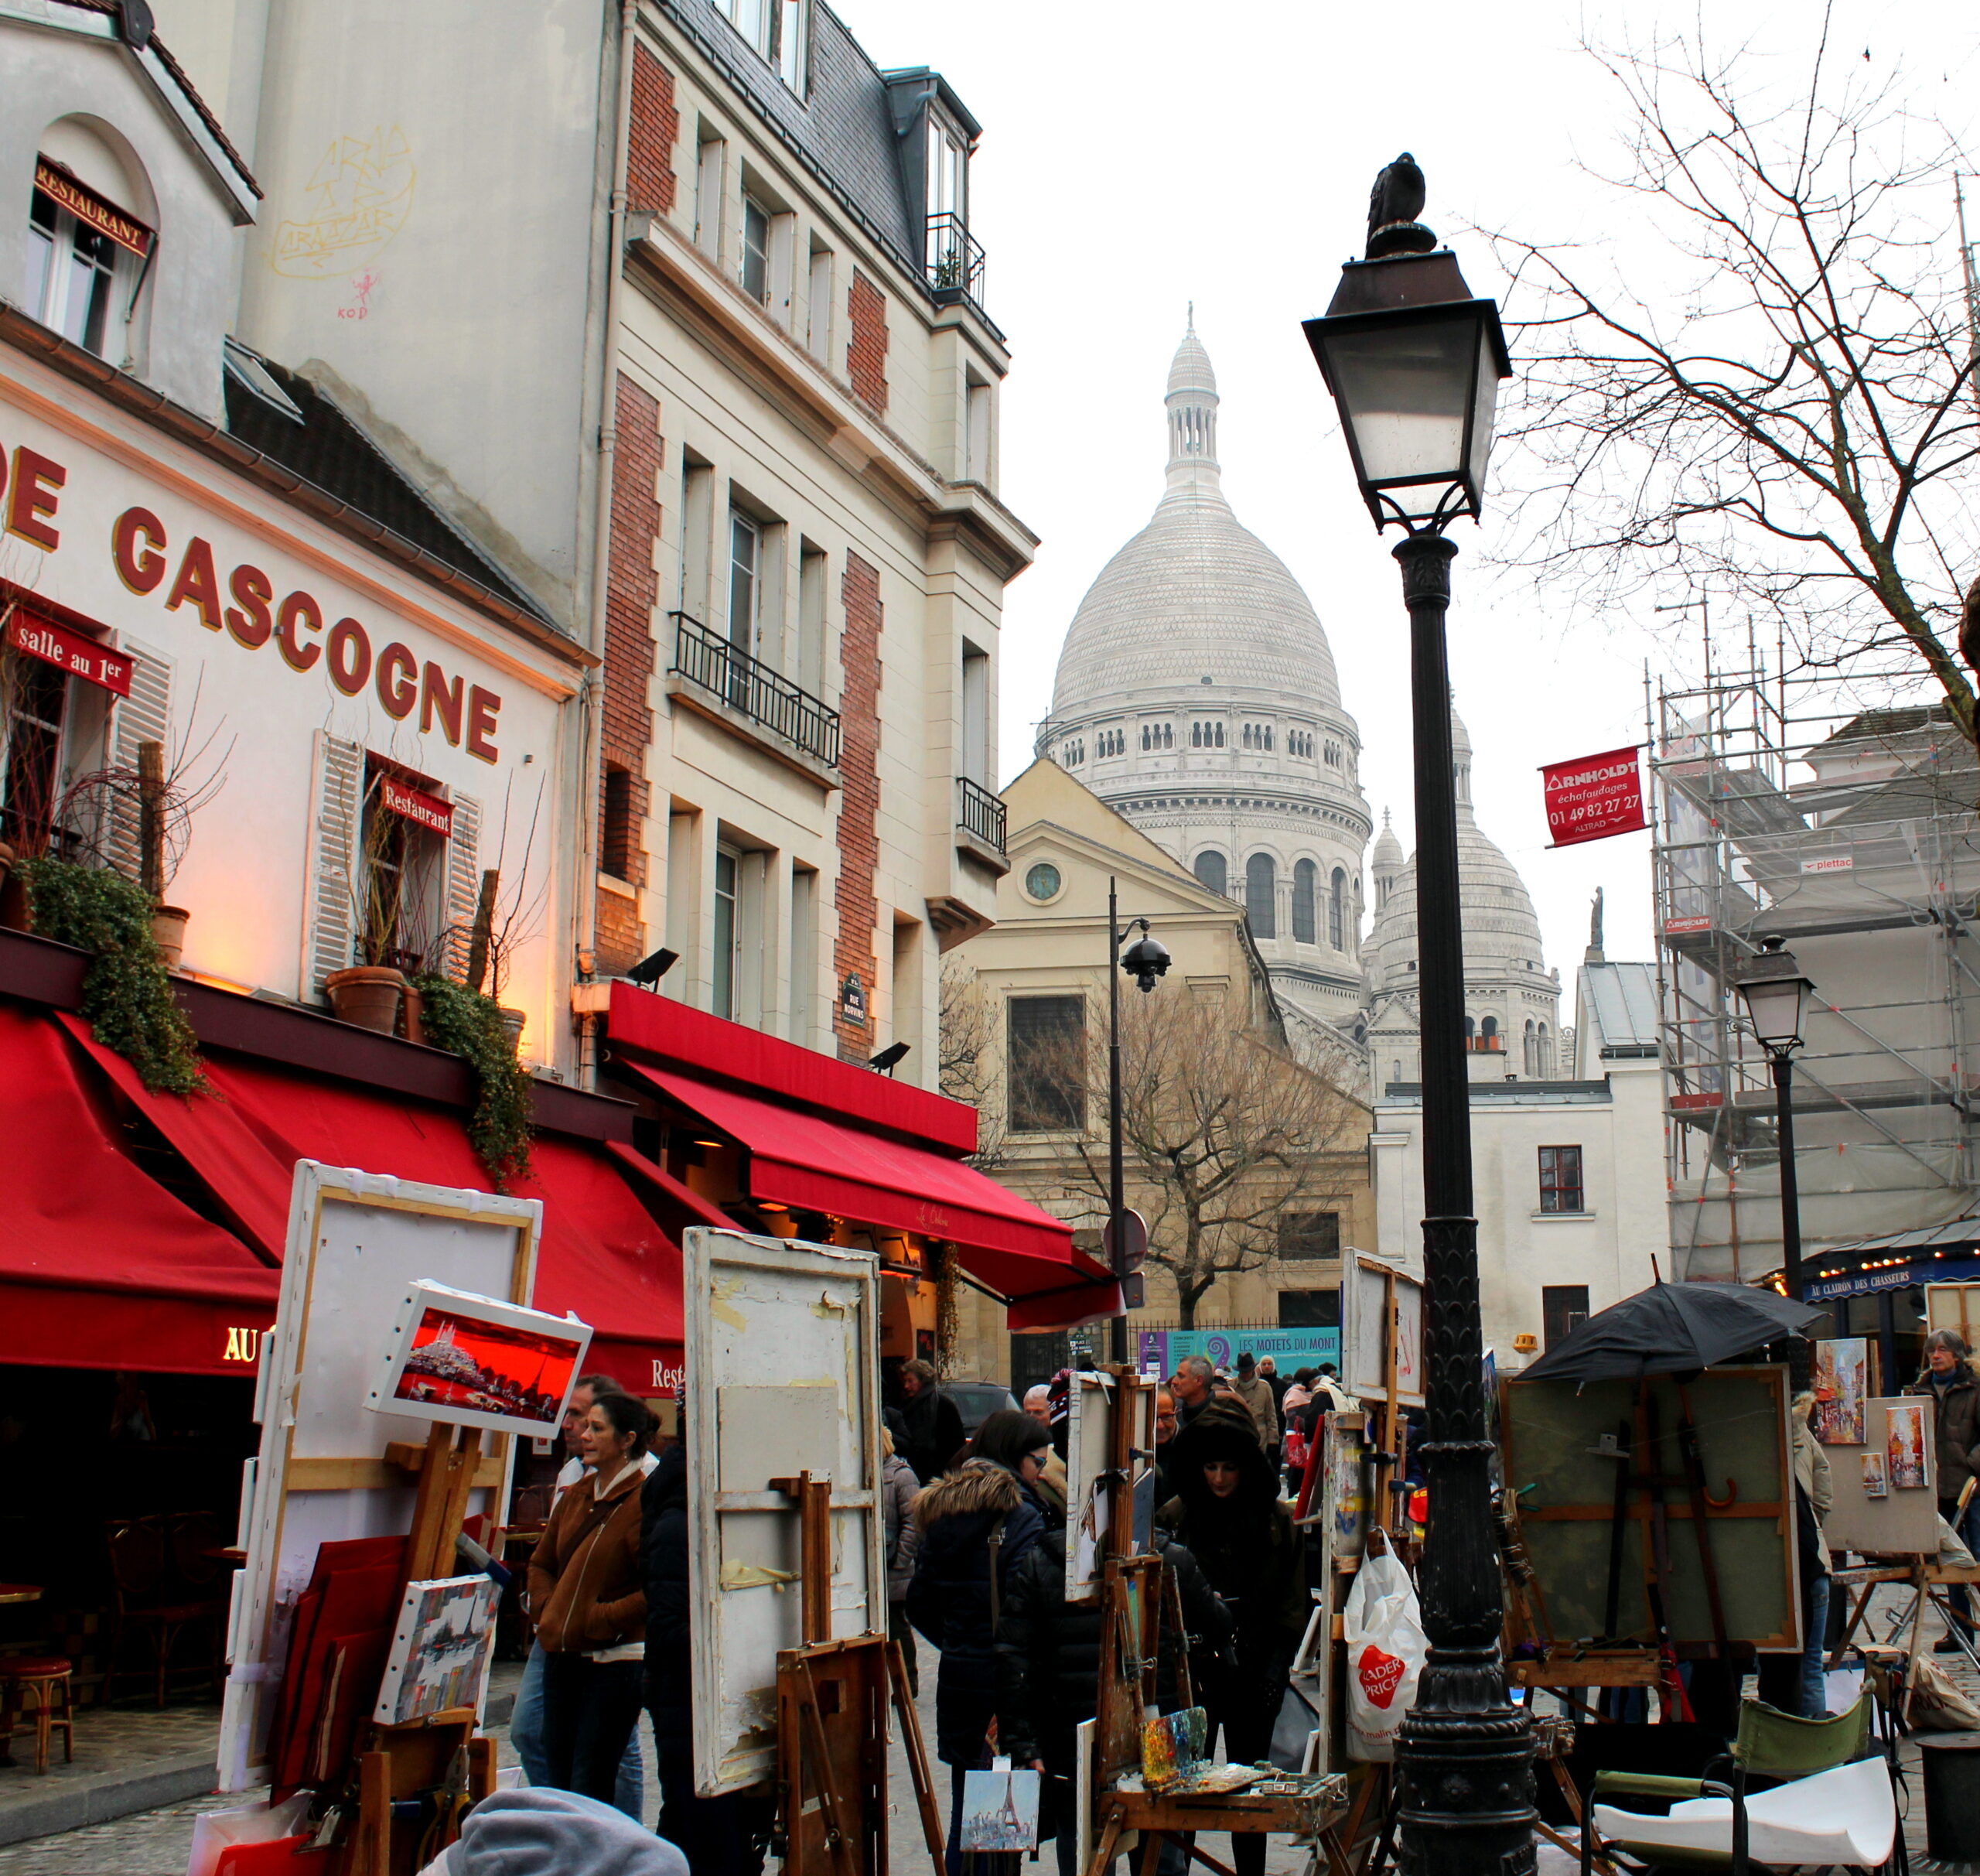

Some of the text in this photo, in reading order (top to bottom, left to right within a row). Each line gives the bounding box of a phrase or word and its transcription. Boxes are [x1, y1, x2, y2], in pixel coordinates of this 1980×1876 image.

[37, 165, 141, 245] RESTAURANT
[338, 307, 367, 320] KOD
[0, 442, 501, 765] E GASCOGNE
[19, 628, 121, 683] salle au 1er
[1546, 761, 1637, 791] ARNHOLDT
[1558, 783, 1627, 804] échafaudages
[386, 786, 449, 832] Restaurant
[1550, 794, 1639, 825] 01 49 82 27 27
[1575, 820, 1606, 833] ALTRAD
[1817, 859, 1852, 870] plettac
[844, 1003, 864, 1019] NORVINS
[849, 993, 859, 1006] RUE
[1811, 1271, 1910, 1297] AU CLAIRON DES CHASSEURS
[223, 1327, 258, 1362] AU
[1239, 1337, 1336, 1352] LES MOTETS DU MONT
[652, 1359, 686, 1389] Rest
[1365, 1675, 1398, 1697] PRICE
